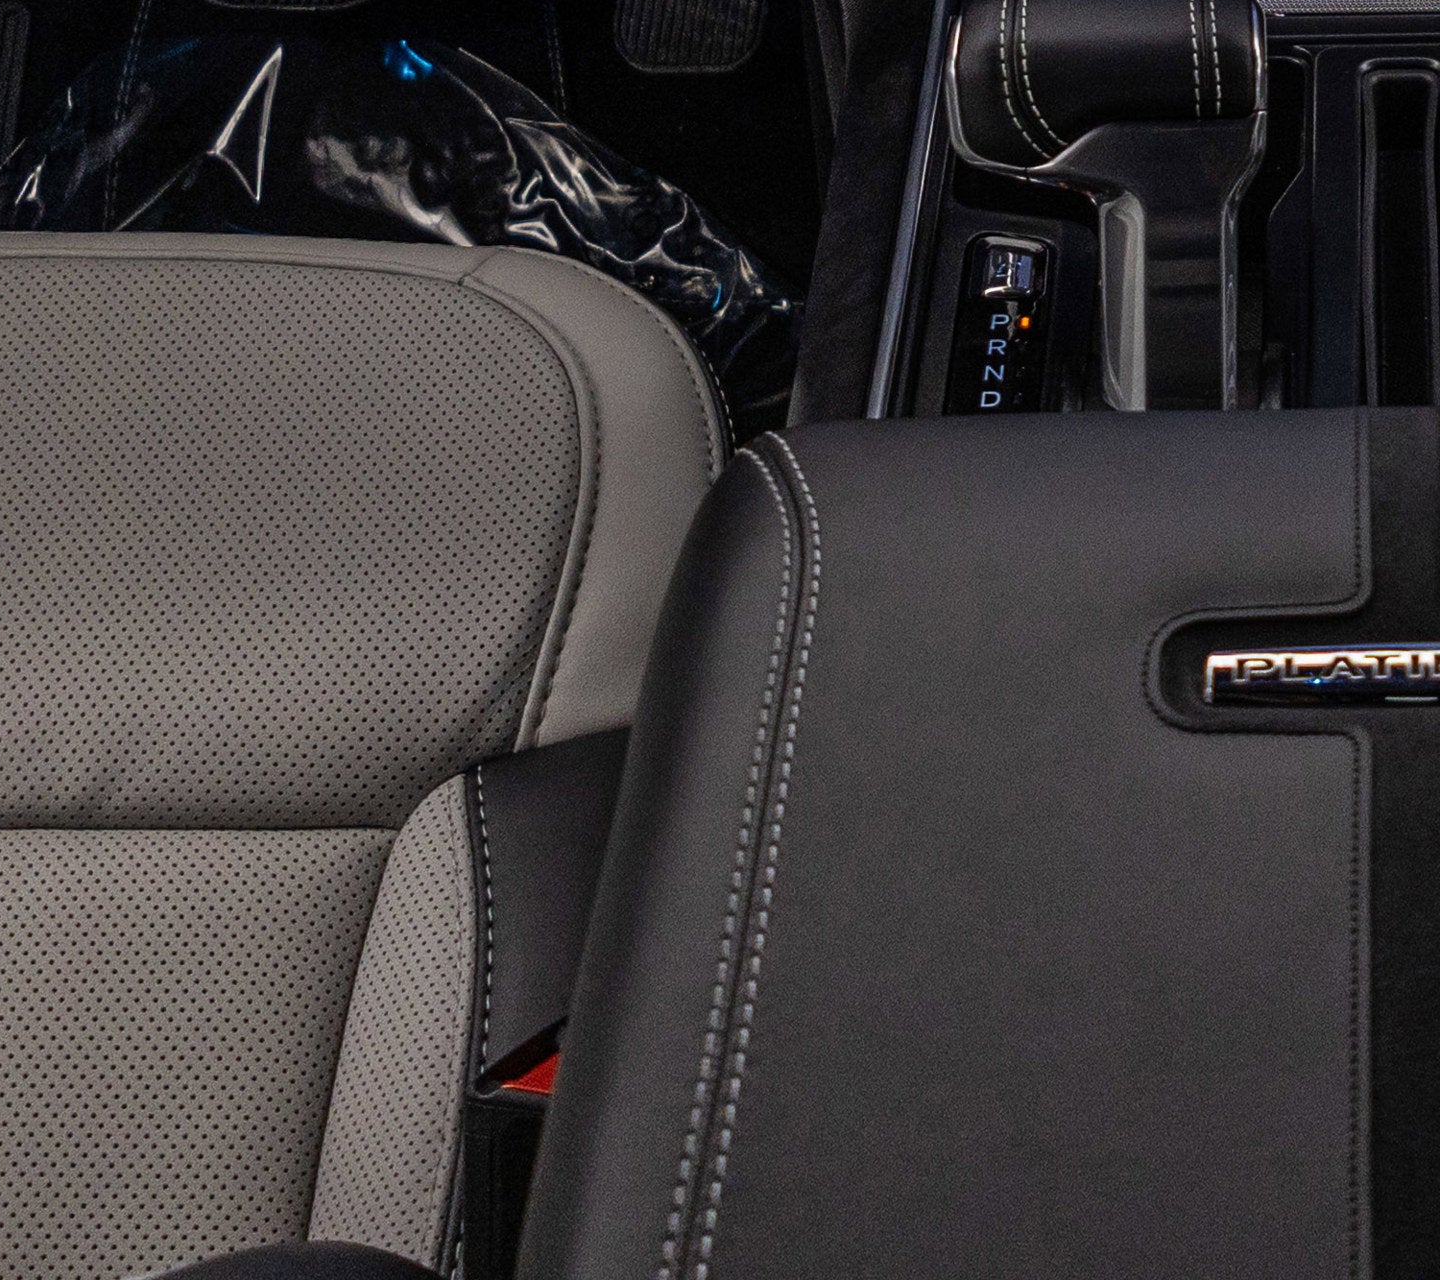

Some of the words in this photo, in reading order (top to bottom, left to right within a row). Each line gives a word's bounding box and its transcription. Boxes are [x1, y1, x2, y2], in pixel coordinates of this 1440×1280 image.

[990, 314, 1010, 330] P
[987, 340, 1006, 355] R
[984, 365, 1005, 381] N
[980, 391, 1001, 407] D
